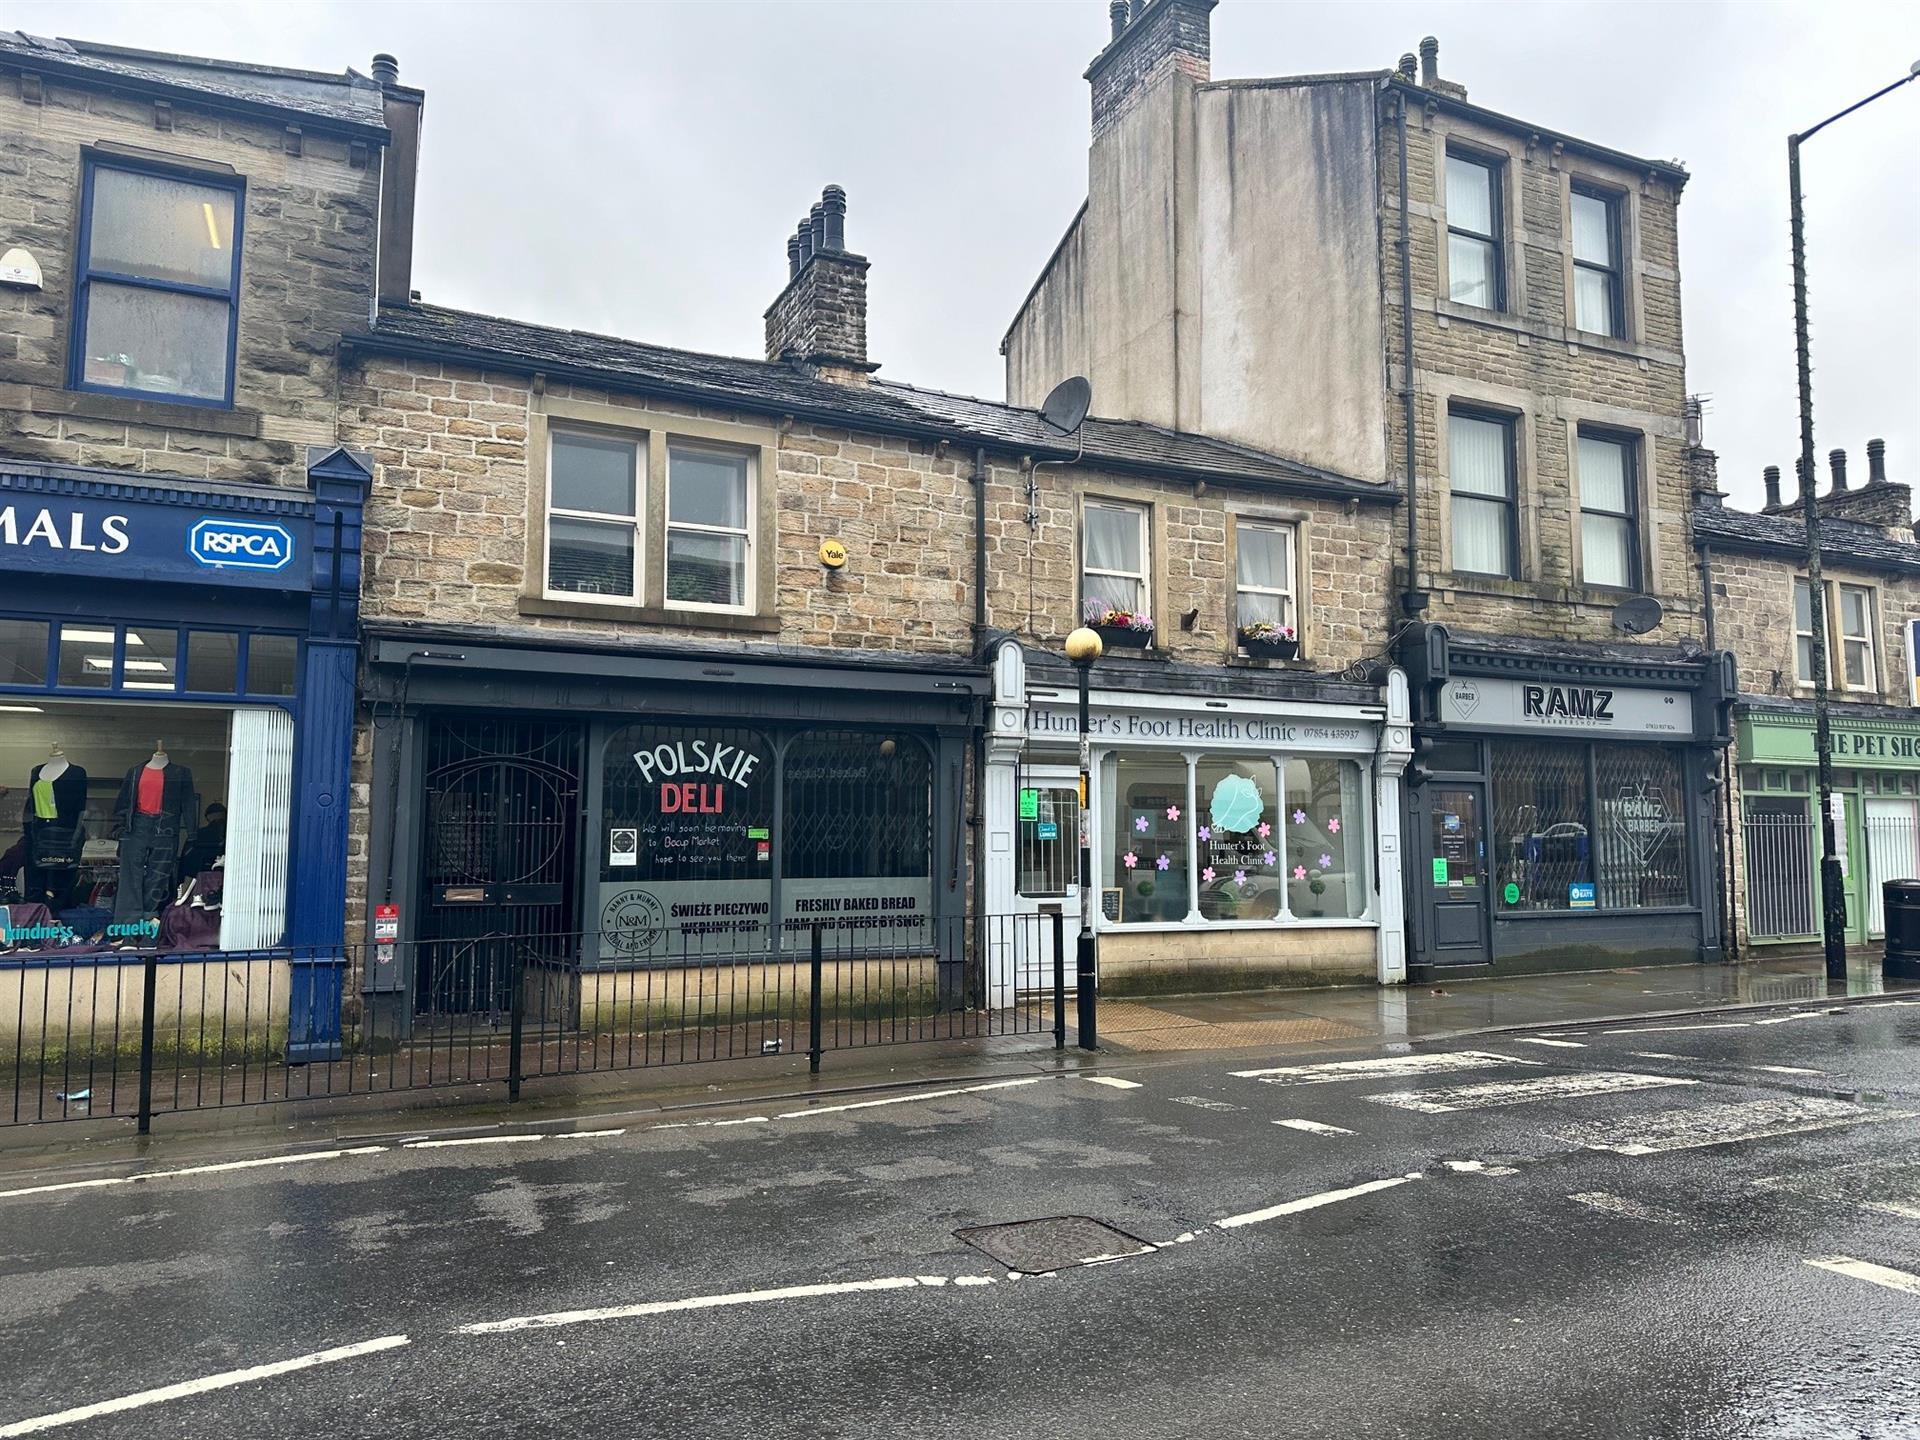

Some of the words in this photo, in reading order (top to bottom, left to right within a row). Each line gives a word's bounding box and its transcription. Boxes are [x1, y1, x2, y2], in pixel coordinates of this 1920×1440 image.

[203, 531, 281, 557] RSPCA
[825, 550, 844, 559] Yale
[1455, 692, 1475, 701] BARBER
[1523, 685, 1614, 720] RAMZ
[1034, 711, 1121, 735] Huner's
[1127, 715, 1172, 737] Foot
[1177, 717, 1239, 740] Health
[1246, 720, 1296, 742] Clinic
[1304, 728, 1329, 739] 07854
[1330, 729, 1360, 740] 435937
[1853, 735, 1886, 755] PET
[633, 740, 760, 789] POLSKIE
[661, 783, 723, 813] DELI
[1624, 803, 1662, 818] RAMZ
[642, 823, 656, 833] We
[661, 822, 675, 833] will
[679, 825, 700, 834] soon
[1628, 820, 1660, 832] BARBER
[648, 838, 657, 847] to
[691, 836, 720, 847] Market
[1210, 840, 1245, 850] Hunter's
[1247, 840, 1265, 850] Foot
[655, 854, 674, 865] hope
[678, 854, 687, 863] to
[690, 855, 706, 863] see
[708, 855, 722, 865] you
[726, 851, 747, 863] there
[1211, 855, 1239, 865] Health
[1240, 855, 1264, 865] Clinic
[609, 895, 628, 912] NANNY
[637, 894, 658, 911] MUMMY
[671, 902, 712, 917] ŚWIEŻE
[714, 902, 769, 915] PIECZYWO
[796, 898, 841, 912] FRESHLY
[844, 897, 879, 911] BAKED
[881, 897, 916, 909] BREAD
[619, 915, 647, 927] N&M
[784, 917, 810, 931] HAM
[838, 915, 878, 929] CHEESE
[880, 915, 894, 928] BY
[5, 923, 74, 940] kindness
[107, 919, 160, 939] cruelty
